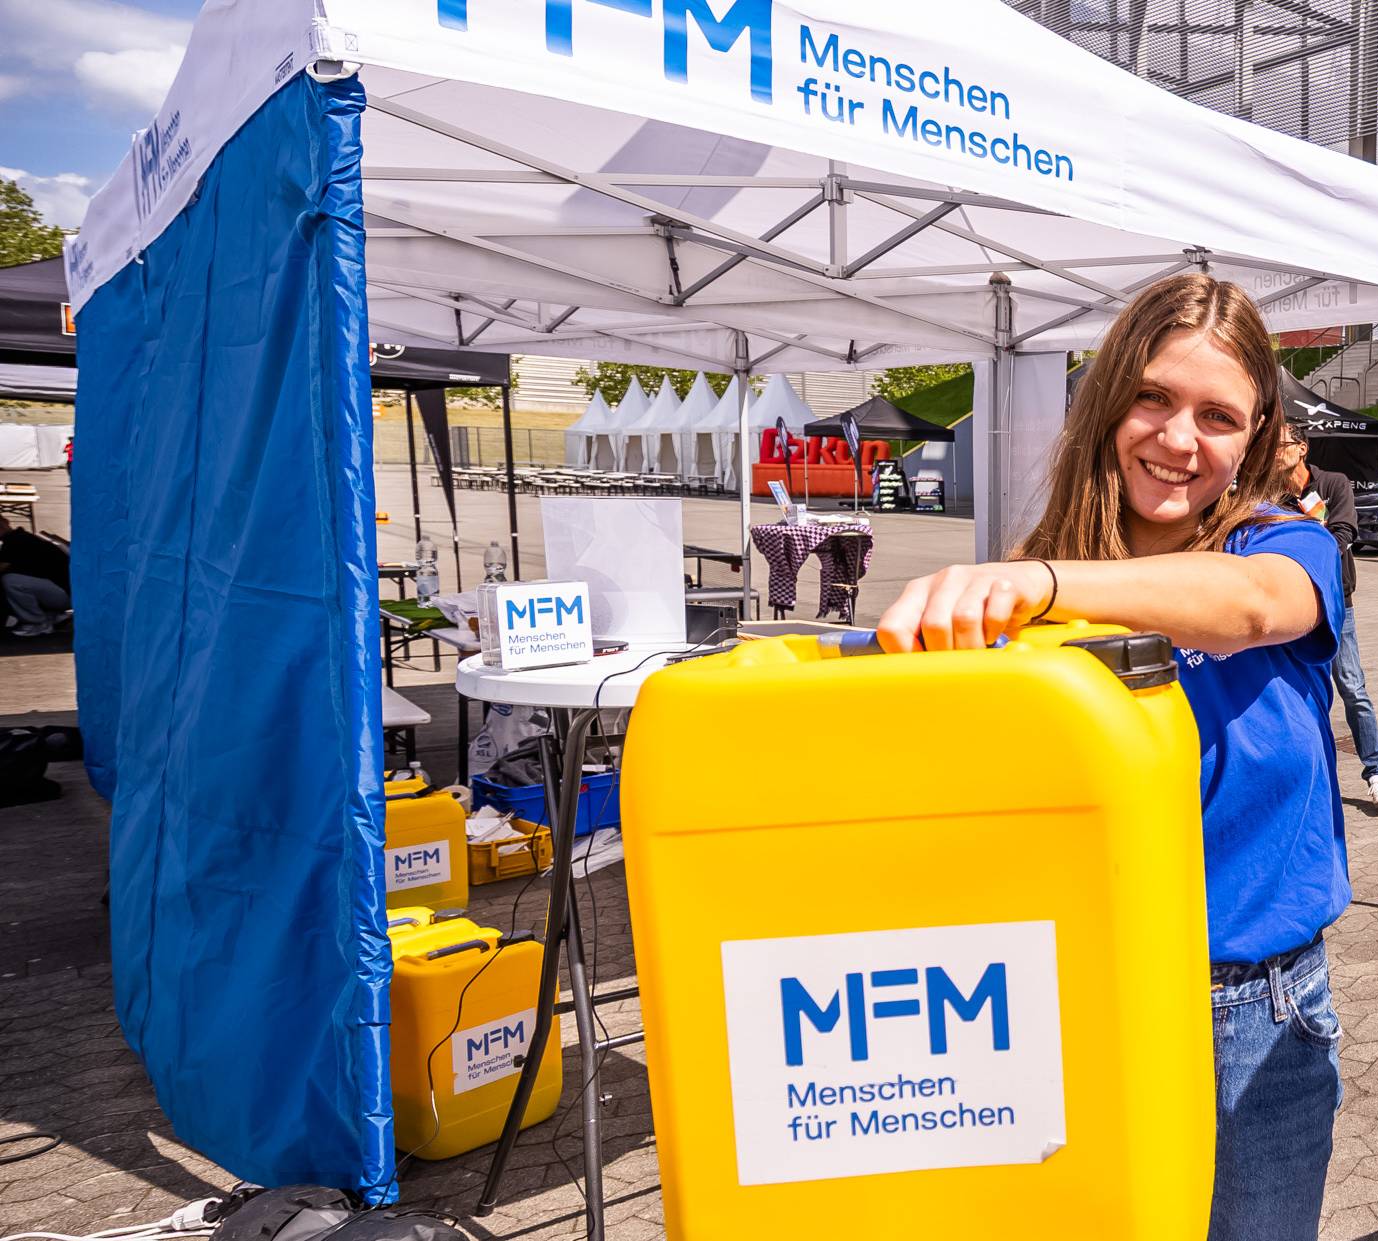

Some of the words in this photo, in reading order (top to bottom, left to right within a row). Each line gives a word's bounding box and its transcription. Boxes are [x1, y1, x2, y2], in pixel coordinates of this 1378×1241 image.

[800, 24, 1010, 120] Menschen
[797, 77, 865, 125] für
[882, 98, 1074, 182] Menschen
[1325, 420, 1367, 430] XPENG
[506, 595, 584, 630] MFM
[508, 631, 566, 645] Menschen
[509, 645, 526, 656] für
[530, 641, 587, 654] Menschen
[394, 848, 440, 871] MFM
[780, 962, 1010, 1067] MFM
[467, 1021, 525, 1062] MFM
[467, 1052, 511, 1073] Menschen
[468, 1070, 481, 1081] für
[787, 1073, 956, 1109] Menschen
[787, 1114, 837, 1142] für
[850, 1102, 1016, 1137] Menschen
